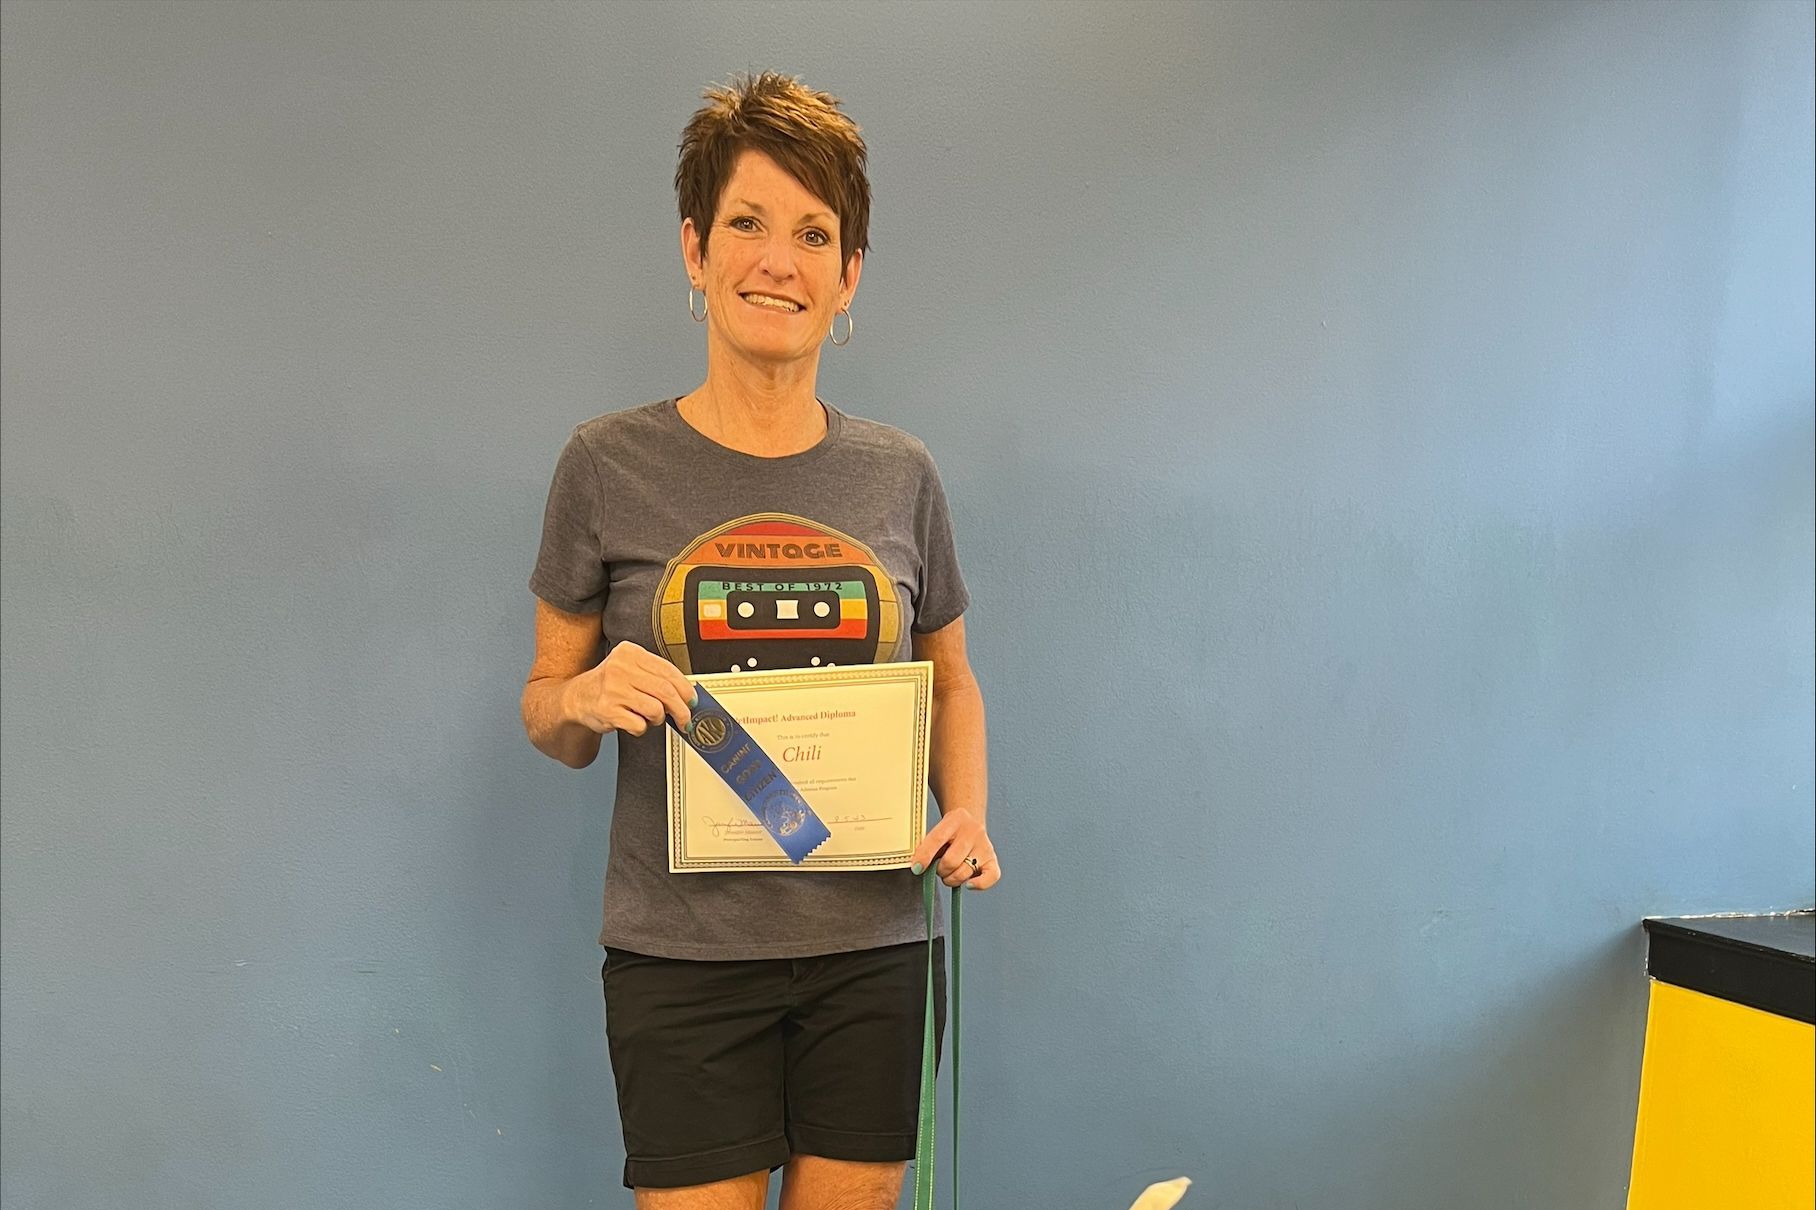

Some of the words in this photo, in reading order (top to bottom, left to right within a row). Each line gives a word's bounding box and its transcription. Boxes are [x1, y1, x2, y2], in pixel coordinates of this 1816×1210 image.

[714, 543, 843, 559] VINTAGE
[722, 582, 764, 591] BEST
[775, 583, 796, 591] OF
[806, 582, 843, 591] 1972
[781, 712, 818, 722] Advanced
[820, 710, 856, 721] Diploma
[782, 744, 822, 763] Chili
[744, 769, 777, 802] CITIZEN
